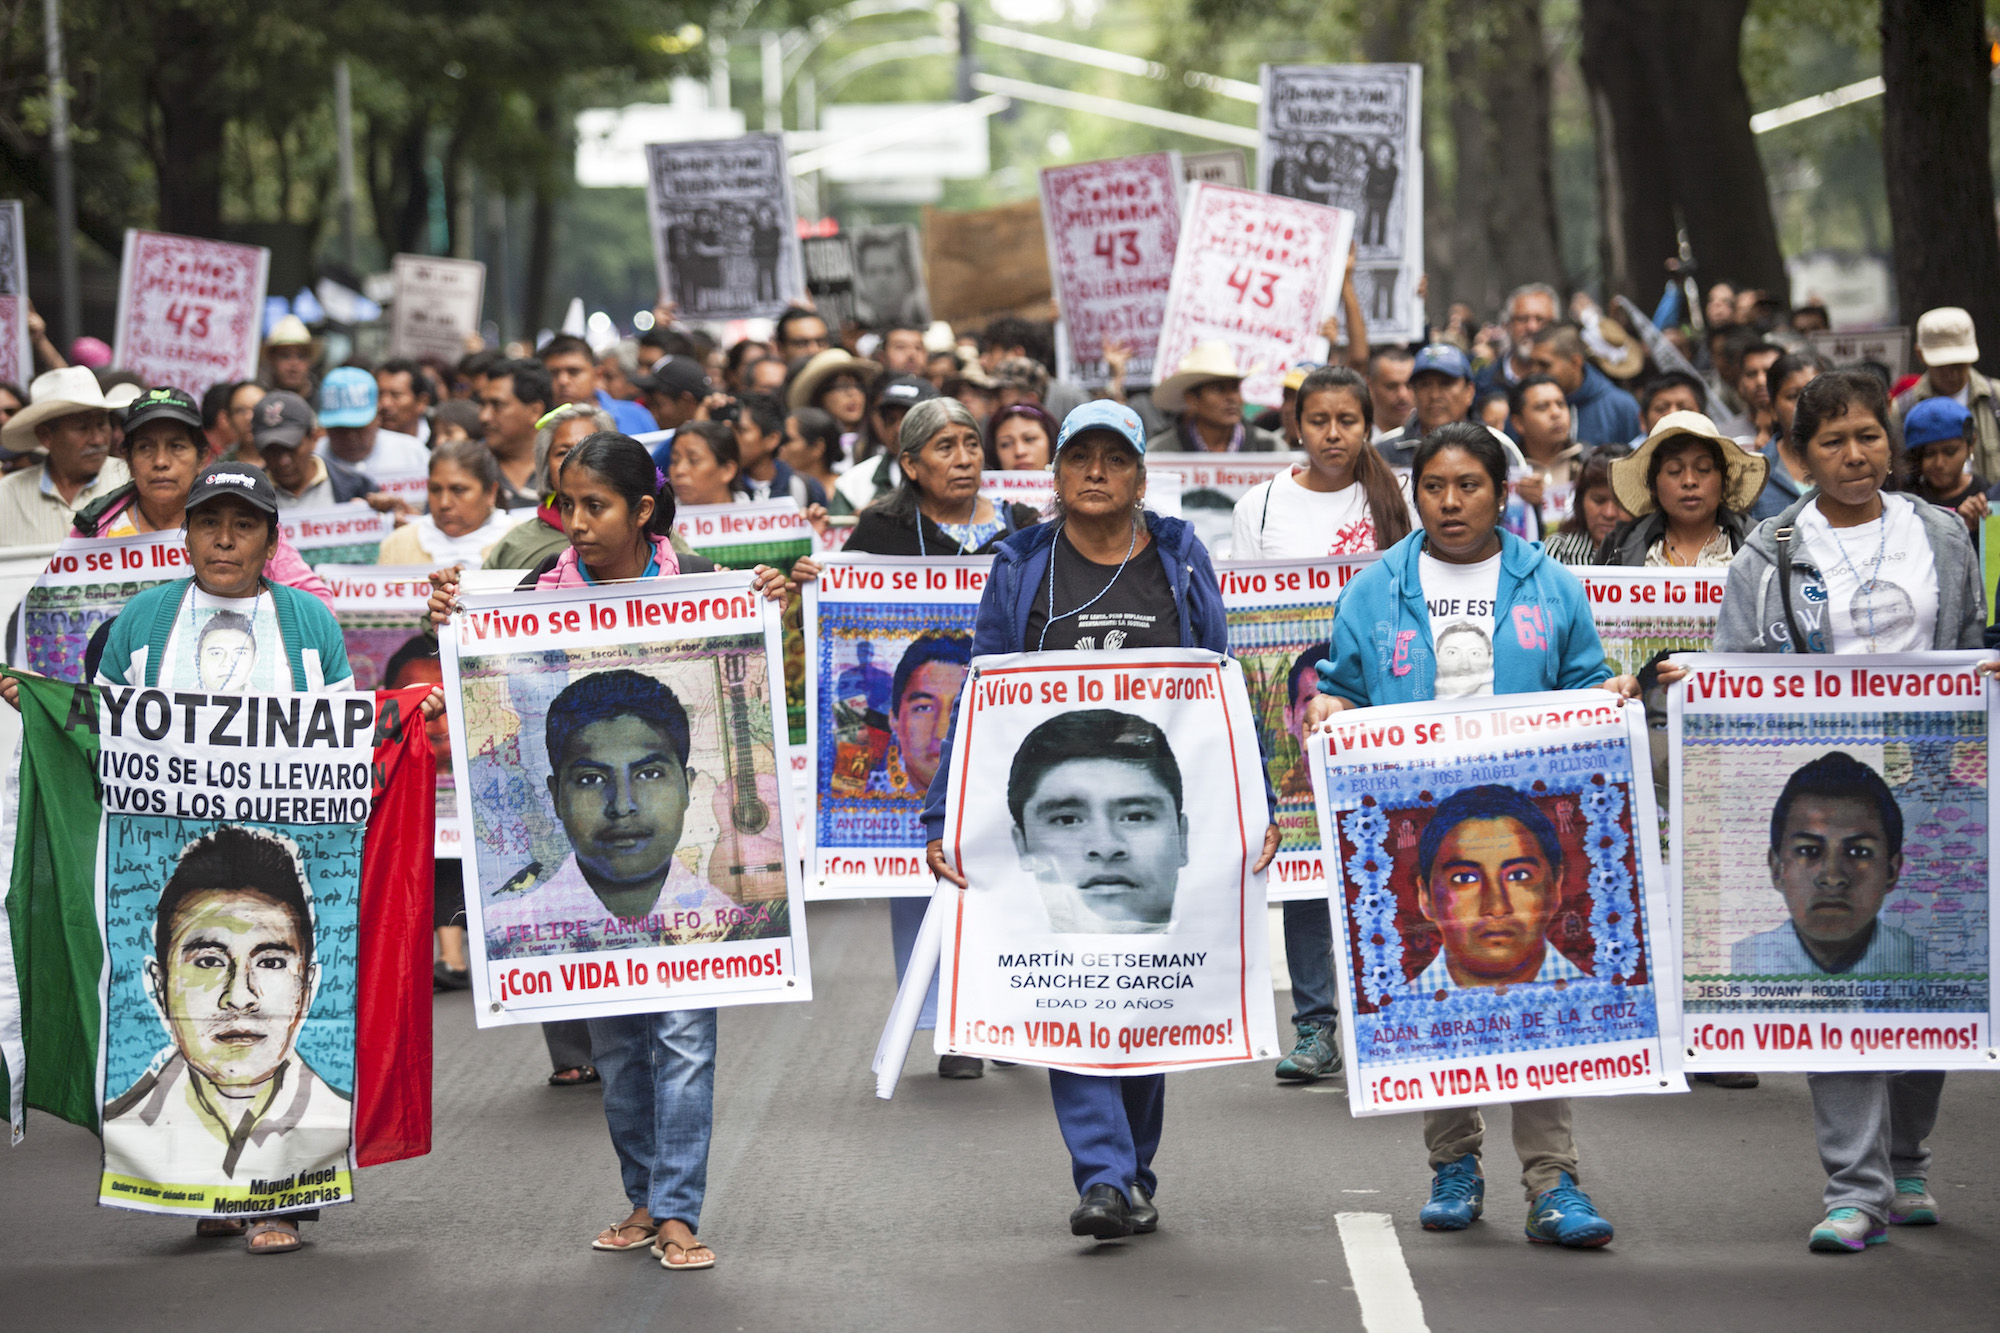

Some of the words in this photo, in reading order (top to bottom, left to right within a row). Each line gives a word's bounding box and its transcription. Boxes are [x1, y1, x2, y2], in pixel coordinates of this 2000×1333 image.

[1094, 230, 1141, 269] 43
[1227, 264, 1281, 310] 43
[166, 302, 213, 339] 43
[695, 518, 714, 536] lo
[85, 551, 113, 571] se
[120, 547, 143, 570] lo
[892, 569, 919, 590] se
[926, 567, 947, 591] lo
[1274, 572, 1300, 592] se
[1308, 567, 1331, 591] lo
[1629, 583, 1656, 604] se
[1664, 580, 1687, 604] lo
[461, 609, 540, 646] ¡Vivo
[549, 611, 580, 635] se
[589, 603, 617, 632] lo
[626, 590, 757, 629] llevaron!
[978, 678, 1033, 711] ¡Vivo
[1040, 680, 1068, 704] se
[1078, 675, 1104, 702] lo
[1114, 673, 1216, 702] llevaron!
[1687, 669, 1764, 703] ¡Vivo
[1774, 674, 1805, 698] se
[1815, 669, 1842, 697] lo
[1851, 669, 1982, 698] llevaron!
[65, 683, 403, 748] AYOTZINAPA
[478, 733, 522, 767] 43
[1329, 722, 1406, 756] ¡Vivo
[1415, 721, 1446, 745] se
[1454, 714, 1482, 741] lo
[167, 757, 197, 784] SE
[206, 761, 251, 789] LOS
[260, 762, 387, 790] LLEVARON
[1331, 766, 1347, 776] Yo,
[1352, 765, 1369, 774] Jan
[1350, 775, 1401, 794] ERIKA
[1430, 769, 1464, 786] JOSE
[1470, 763, 1519, 782] ANGEL
[1549, 753, 1609, 774] ALLISON
[177, 791, 226, 820] LOS
[486, 821, 531, 857] 43
[836, 817, 900, 831] ANTONIO
[825, 856, 866, 877] ¡Con
[873, 856, 921, 877] VIDA
[1277, 858, 1325, 882] VIDA
[506, 920, 589, 944] FELIPE
[603, 911, 702, 936] ARNULFO
[715, 905, 771, 928] ROSA
[998, 949, 1074, 968] MARTÍN
[1081, 951, 1208, 968] GETSEMANY
[500, 968, 553, 1002] ¡Con
[560, 960, 621, 992] VIDA
[628, 958, 649, 987] lo
[656, 948, 783, 989] queremos!
[1010, 972, 1110, 989] SÁNCHEZ
[1116, 971, 1195, 990] GARCÍA
[1698, 983, 1741, 998] JESÚS
[1751, 985, 1803, 998] JOVANY
[1811, 982, 1891, 998] RODRÍGUEZ
[1900, 984, 1971, 998] TLATEMPA
[1036, 998, 1088, 1010] EDAD
[1094, 998, 1117, 1010] 20
[1123, 996, 1174, 1010] AÑOS
[965, 1019, 1015, 1047] ¡Con
[1024, 1020, 1083, 1048] VIDA
[1090, 1020, 1111, 1050] lo
[1118, 1018, 1234, 1054] queremos!
[1373, 1022, 1419, 1045] ADÁN
[1430, 1013, 1512, 1038] ABRAJÁN
[1522, 1011, 1545, 1029] DE
[1558, 1007, 1581, 1025] LA
[1591, 1001, 1638, 1021] CRUZ
[1693, 1023, 1744, 1050] ¡Con
[1753, 1022, 1814, 1050] VIDA
[1821, 1022, 1843, 1050] lo
[1851, 1022, 1978, 1055] queremos!
[1369, 1047, 1391, 1058] Hijo
[1396, 1046, 1406, 1054] de
[1452, 1041, 1458, 1050] y
[1372, 1076, 1424, 1105] ¡Con
[1430, 1066, 1491, 1097] VIDA
[1496, 1063, 1519, 1090] lo
[1526, 1048, 1651, 1092] queremos!
[111, 1180, 137, 1195] Quiero
[138, 1184, 161, 1198] saber
[249, 1173, 296, 1197] Miguel
[298, 1165, 337, 1187] Ángel
[212, 1196, 276, 1215] Mendoza
